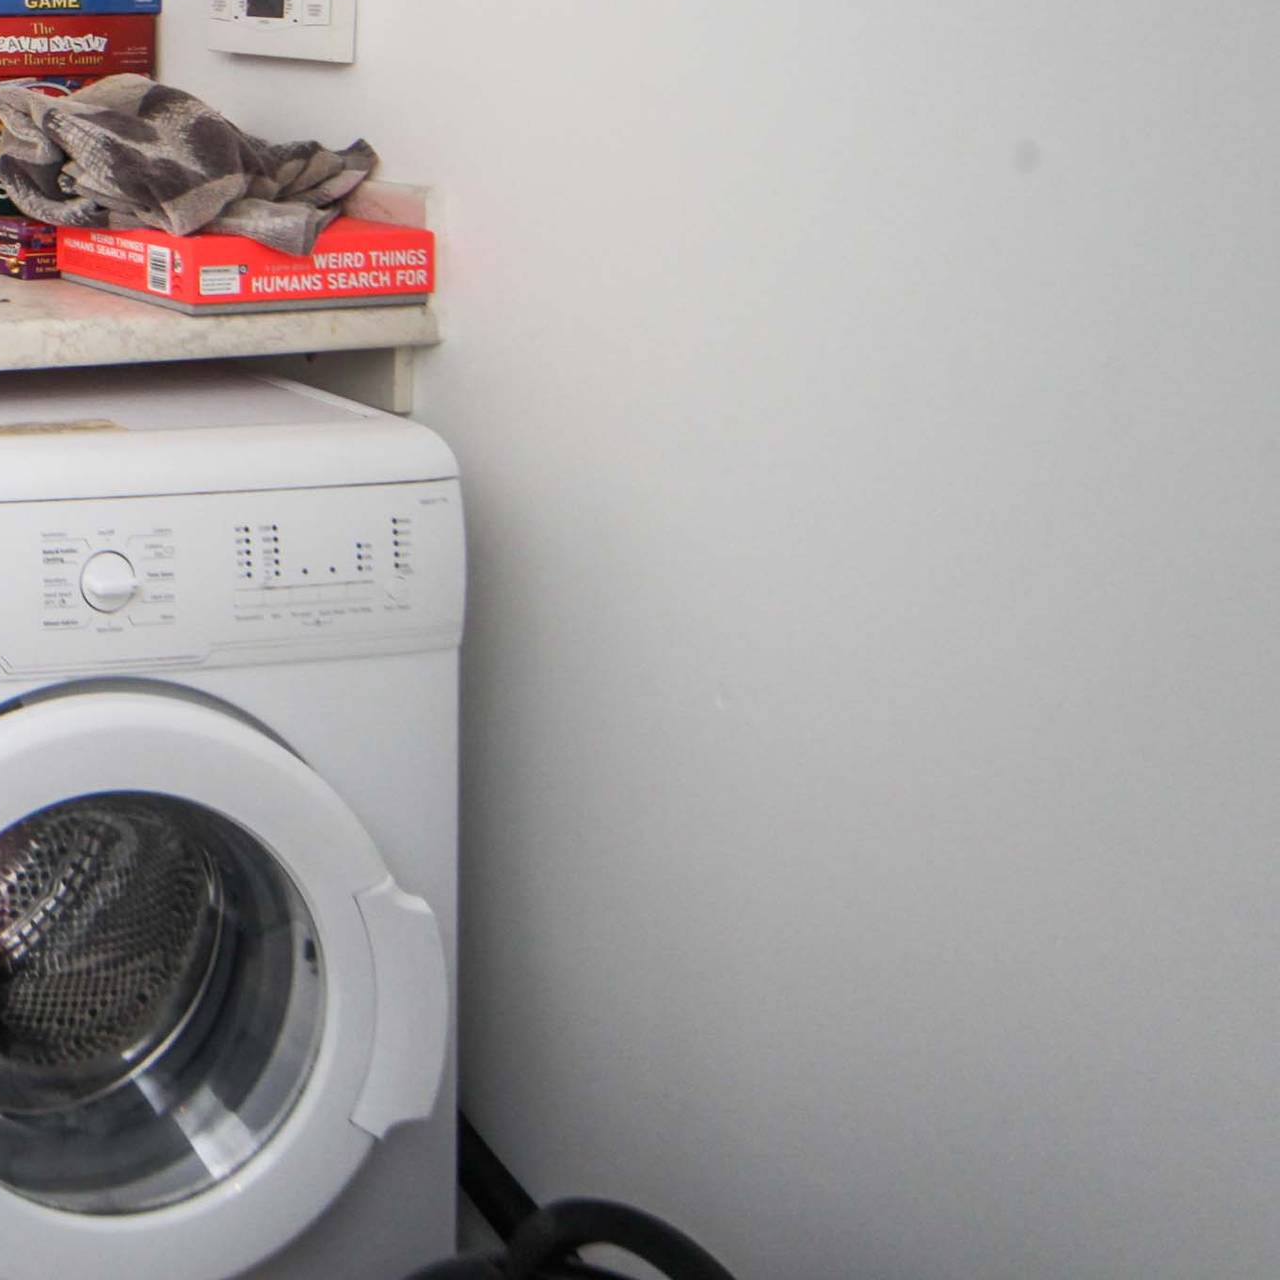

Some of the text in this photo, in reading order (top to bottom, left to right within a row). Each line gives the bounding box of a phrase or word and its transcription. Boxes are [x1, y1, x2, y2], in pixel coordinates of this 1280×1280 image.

[30, 22, 55, 35] The
[24, 53, 66, 67] Racing
[69, 53, 104, 66] Game
[90, 232, 145, 252] WEIRD THINGS
[312, 251, 365, 270] WEIRD
[369, 249, 427, 267] THINGS
[251, 274, 322, 293] HUMANS
[327, 271, 390, 289] SEARCH
[396, 269, 428, 286] FOR
